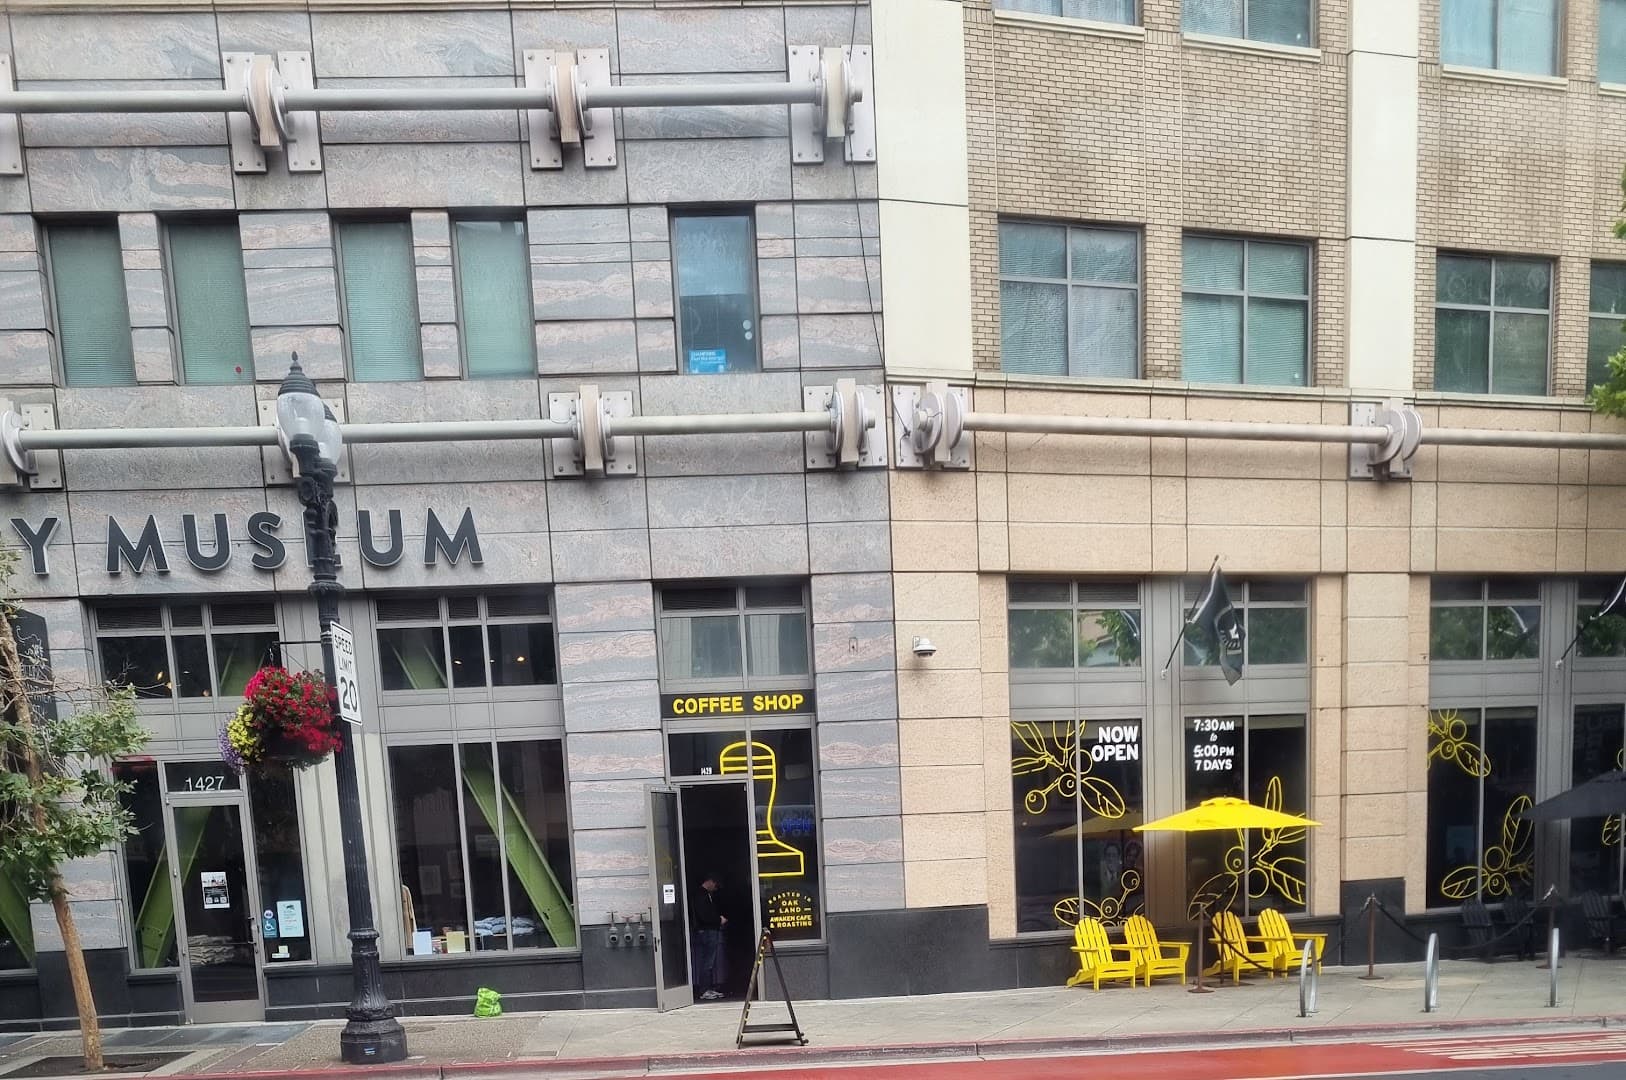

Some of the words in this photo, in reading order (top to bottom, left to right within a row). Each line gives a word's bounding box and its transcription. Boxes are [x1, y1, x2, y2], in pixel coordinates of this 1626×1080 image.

[10, 517, 60, 574] Y
[334, 633, 353, 655] SPEED
[338, 655, 353, 675] LIMIT
[340, 676, 358, 712] 20
[673, 696, 744, 714] COFFEE
[752, 694, 804, 711] SHOP
[1098, 725, 1139, 744] NOW
[1193, 719, 1219, 732] 7:30
[1091, 743, 1139, 762] OPEN
[1219, 746, 1235, 757] PM
[1194, 759, 1202, 771] 7
[1203, 758, 1233, 771] DAYS
[185, 775, 225, 792] 1427
[768, 891, 801, 905] ROASTED
[779, 906, 801, 914] LAND
[776, 920, 813, 928] ROASTING
